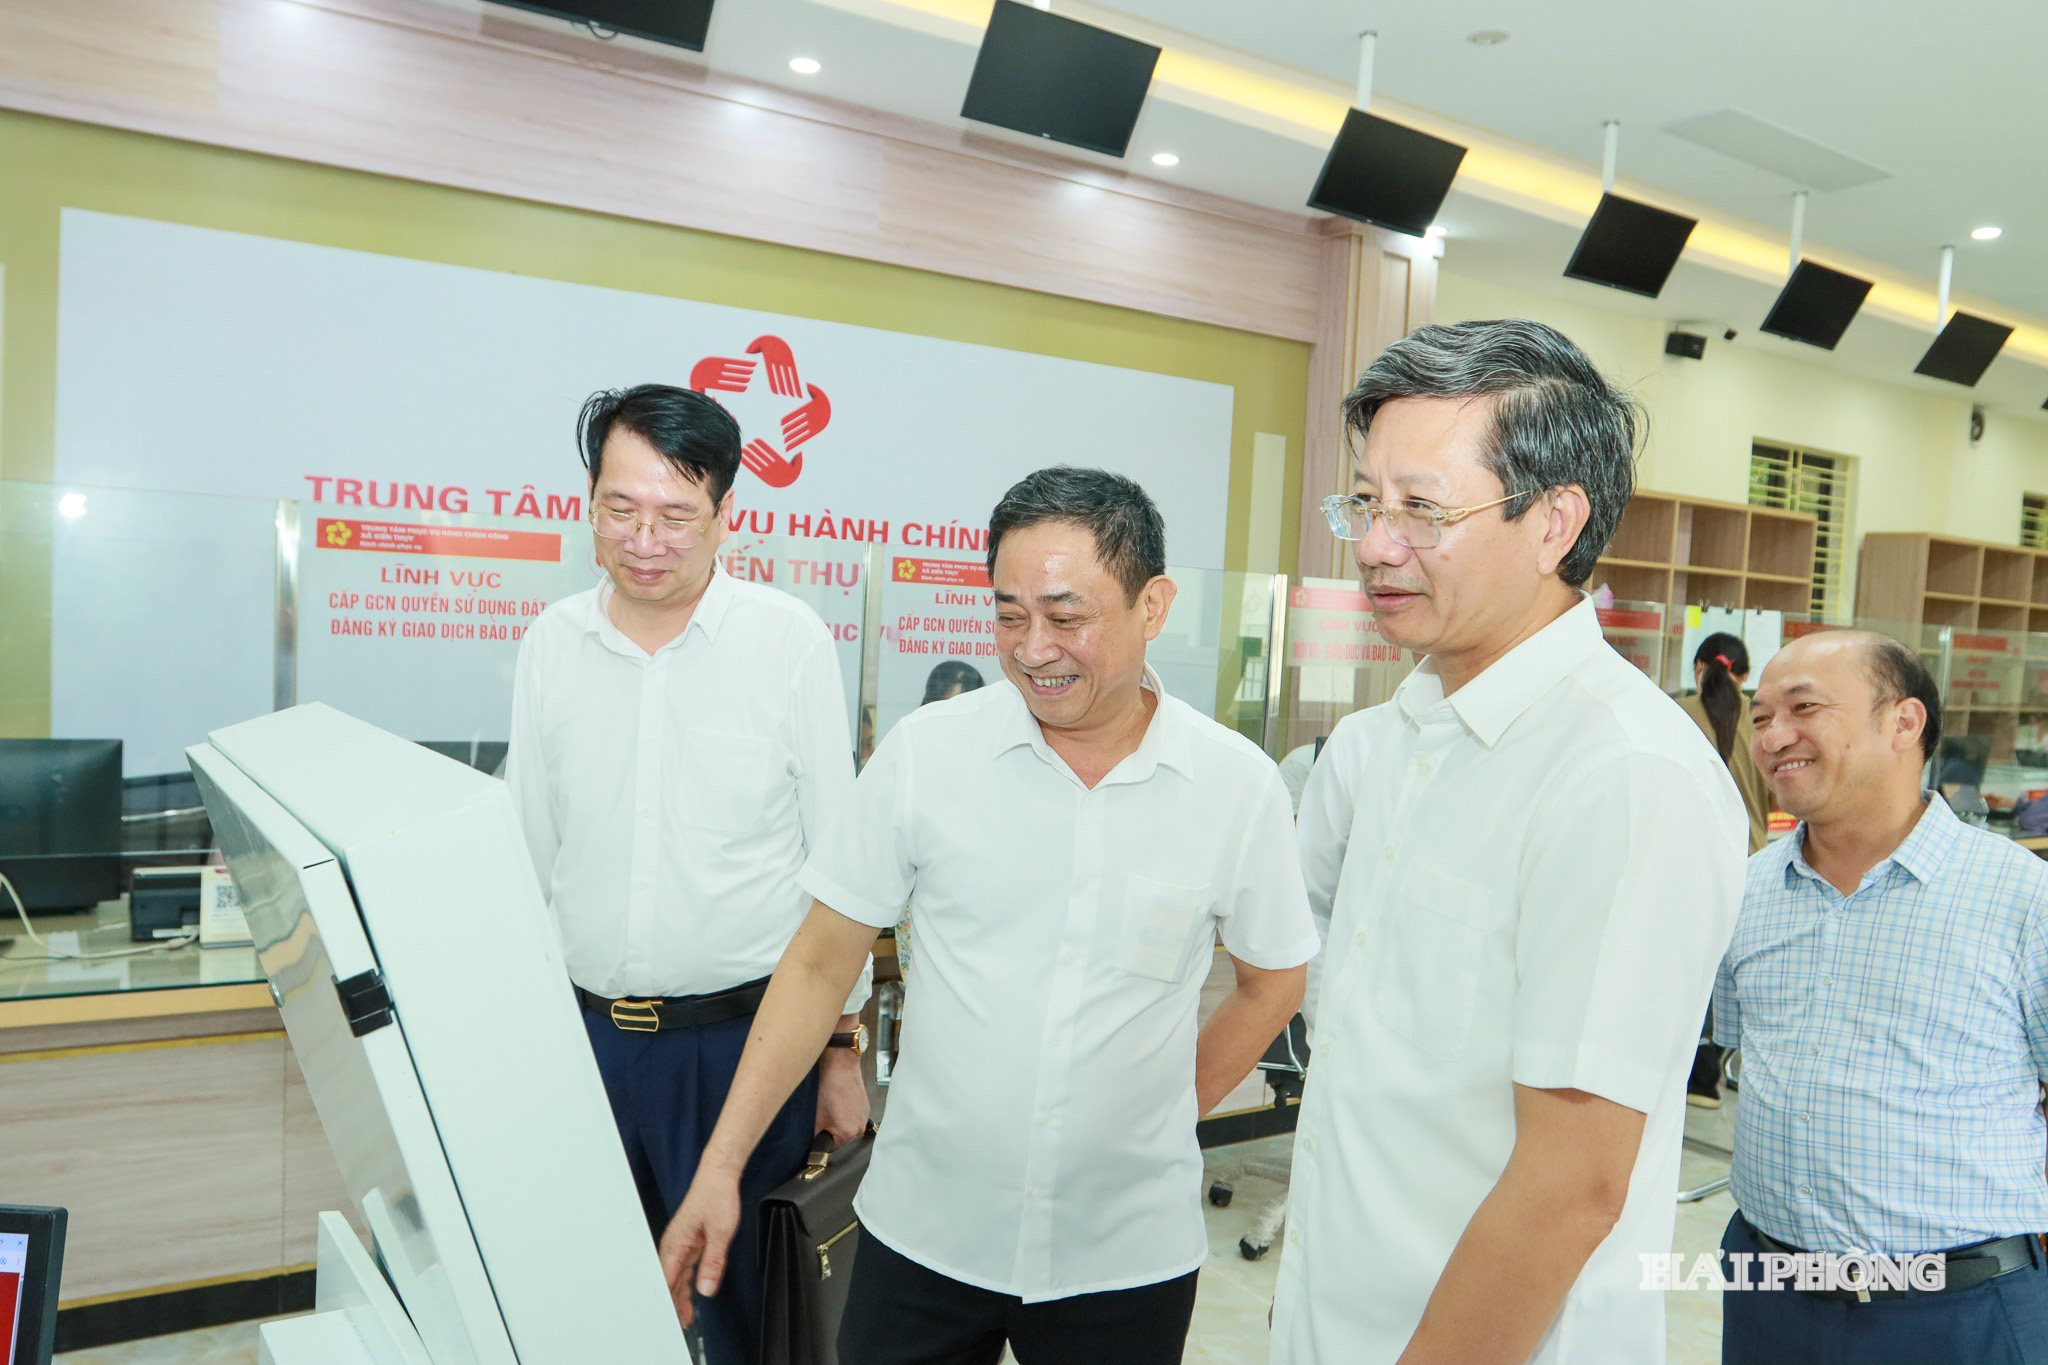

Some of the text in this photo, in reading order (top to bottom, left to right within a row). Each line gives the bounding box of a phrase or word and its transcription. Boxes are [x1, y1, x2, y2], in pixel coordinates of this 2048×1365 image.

[304, 475, 470, 515] TRUNG
[485, 484, 581, 522] TÂM
[728, 509, 774, 544] VỤ
[788, 509, 889, 544] HÀNH
[381, 563, 502, 592] LĨNH VỰC
[718, 545, 864, 596] ẾN THỤ
[365, 593, 396, 611] GCN
[935, 589, 976, 606] LĨNH
[378, 617, 397, 637] KÝ
[402, 621, 436, 638] GIAO
[441, 623, 475, 642] DỊCH
[923, 617, 945, 632] GCN
[931, 637, 945, 655] KÝ
[948, 640, 972, 656] GIAO
